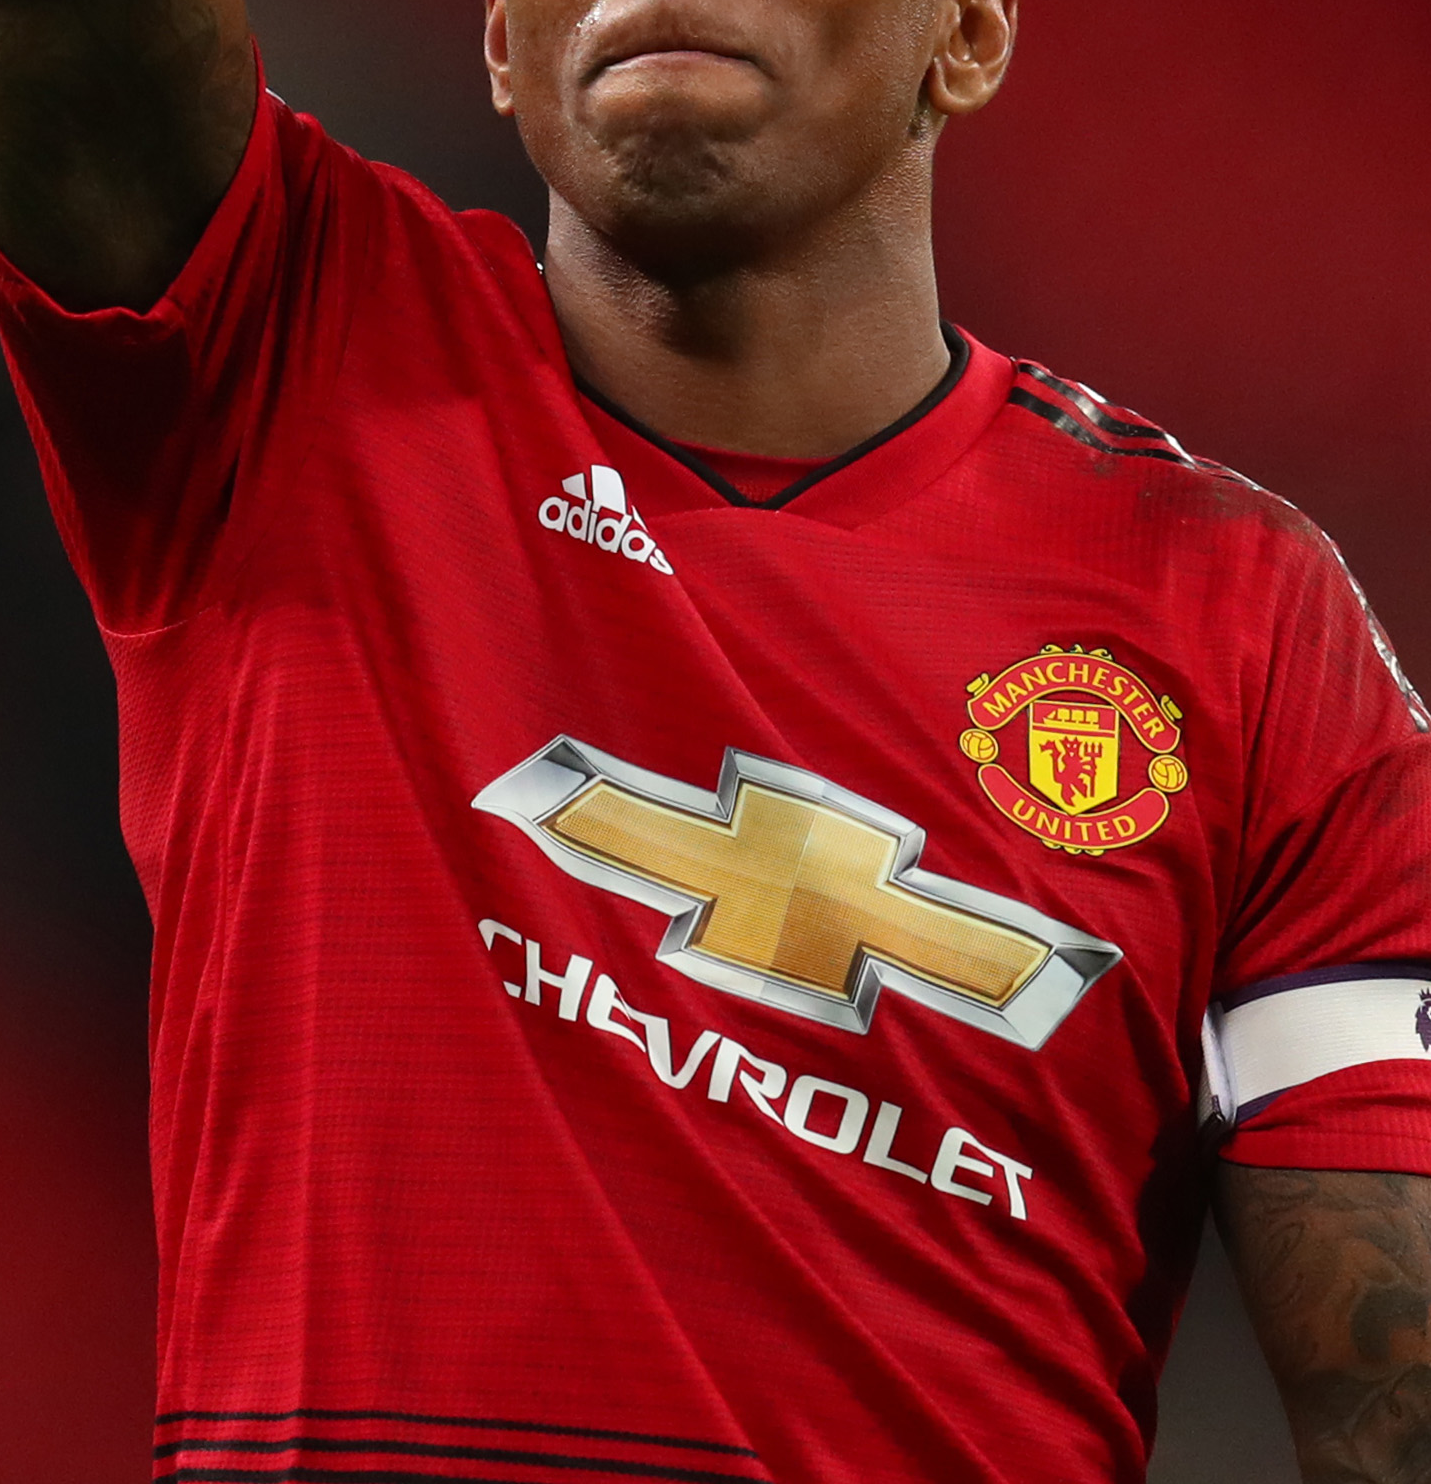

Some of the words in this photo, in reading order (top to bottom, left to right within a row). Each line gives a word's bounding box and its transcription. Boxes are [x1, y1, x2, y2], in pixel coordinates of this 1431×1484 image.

[538, 496, 675, 576] adidas
[981, 661, 1166, 739] MANCHESTER
[1011, 797, 1137, 842] UNITED
